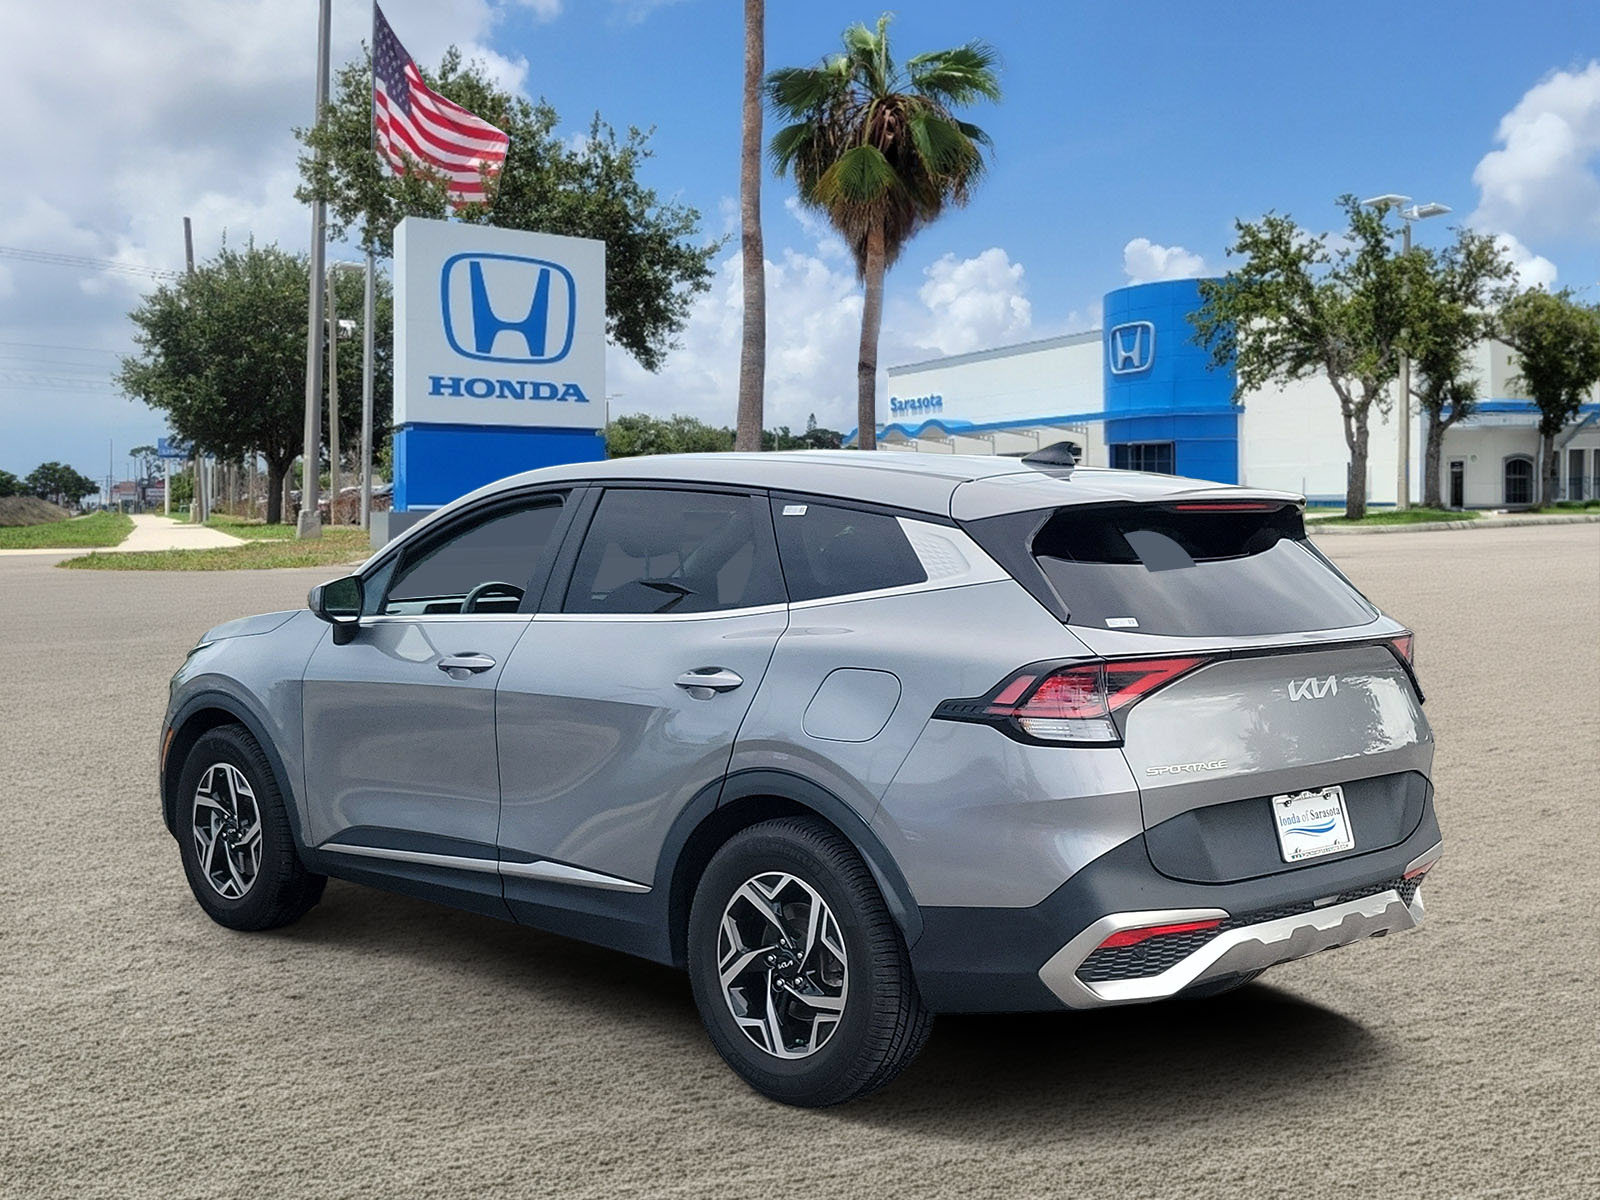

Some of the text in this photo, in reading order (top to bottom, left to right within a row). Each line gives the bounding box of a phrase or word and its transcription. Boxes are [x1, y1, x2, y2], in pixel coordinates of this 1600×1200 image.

[428, 376, 590, 403] HONDA
[890, 394, 943, 412] Sarasota
[1287, 675, 1338, 701] KIA
[1146, 759, 1228, 776] SPORTAGE
[1301, 809, 1310, 823] of
[1310, 807, 1341, 821] Sarasota
